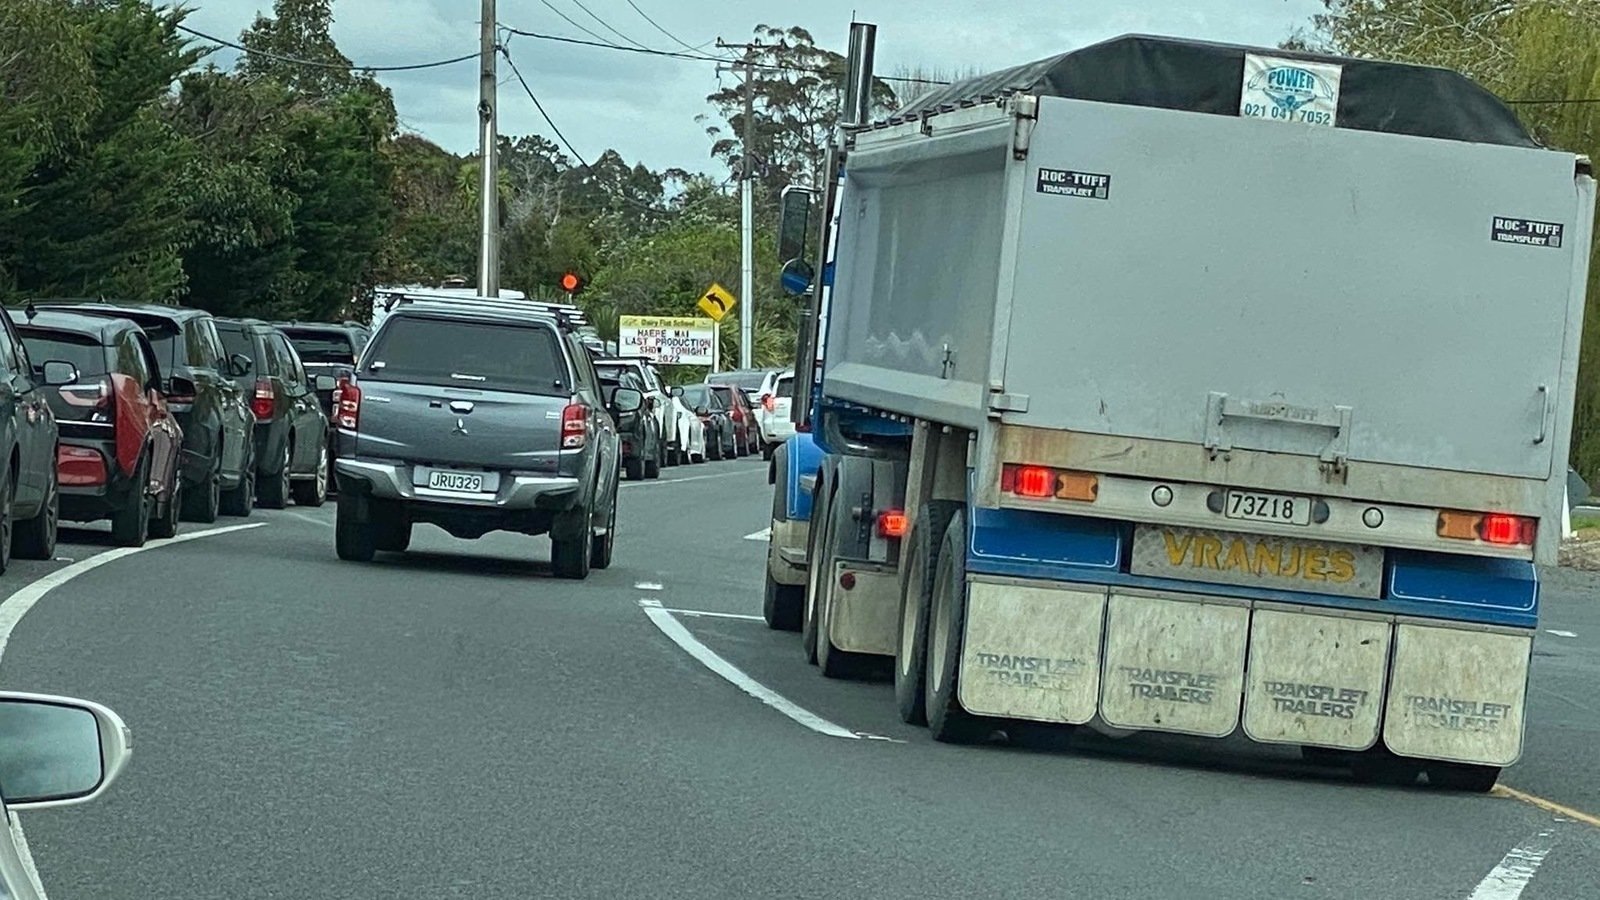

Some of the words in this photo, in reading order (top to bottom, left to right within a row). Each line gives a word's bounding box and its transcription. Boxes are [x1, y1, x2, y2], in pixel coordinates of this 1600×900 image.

[1268, 69, 1315, 89] POWER
[1245, 103, 1266, 117] 021
[1271, 108, 1293, 121] 041
[1300, 111, 1330, 125] 7052
[1040, 170, 1107, 187] ROC-TUFF
[1042, 184, 1093, 197] TRANSFLEET
[1495, 218, 1560, 235] ROC-TUFF
[1496, 233, 1547, 245] TRANSFLEET
[641, 319, 658, 327] Dairy
[659, 319, 672, 327] Flat
[625, 337, 647, 345] LAST
[655, 338, 711, 347] PRODUCTION
[674, 330, 690, 338] MAI
[657, 355, 680, 363] 2022
[671, 347, 708, 355] TONIGHT
[431, 474, 481, 490] JRU329
[1231, 494, 1294, 519] 73Z18
[1163, 531, 1356, 583] VRANJES
[1130, 683, 1214, 705] TRAILERS
[1263, 681, 1368, 706] TRANSFLEET
[1273, 698, 1355, 720] TRAILERS
[1405, 695, 1511, 719] TRANSFLEET
